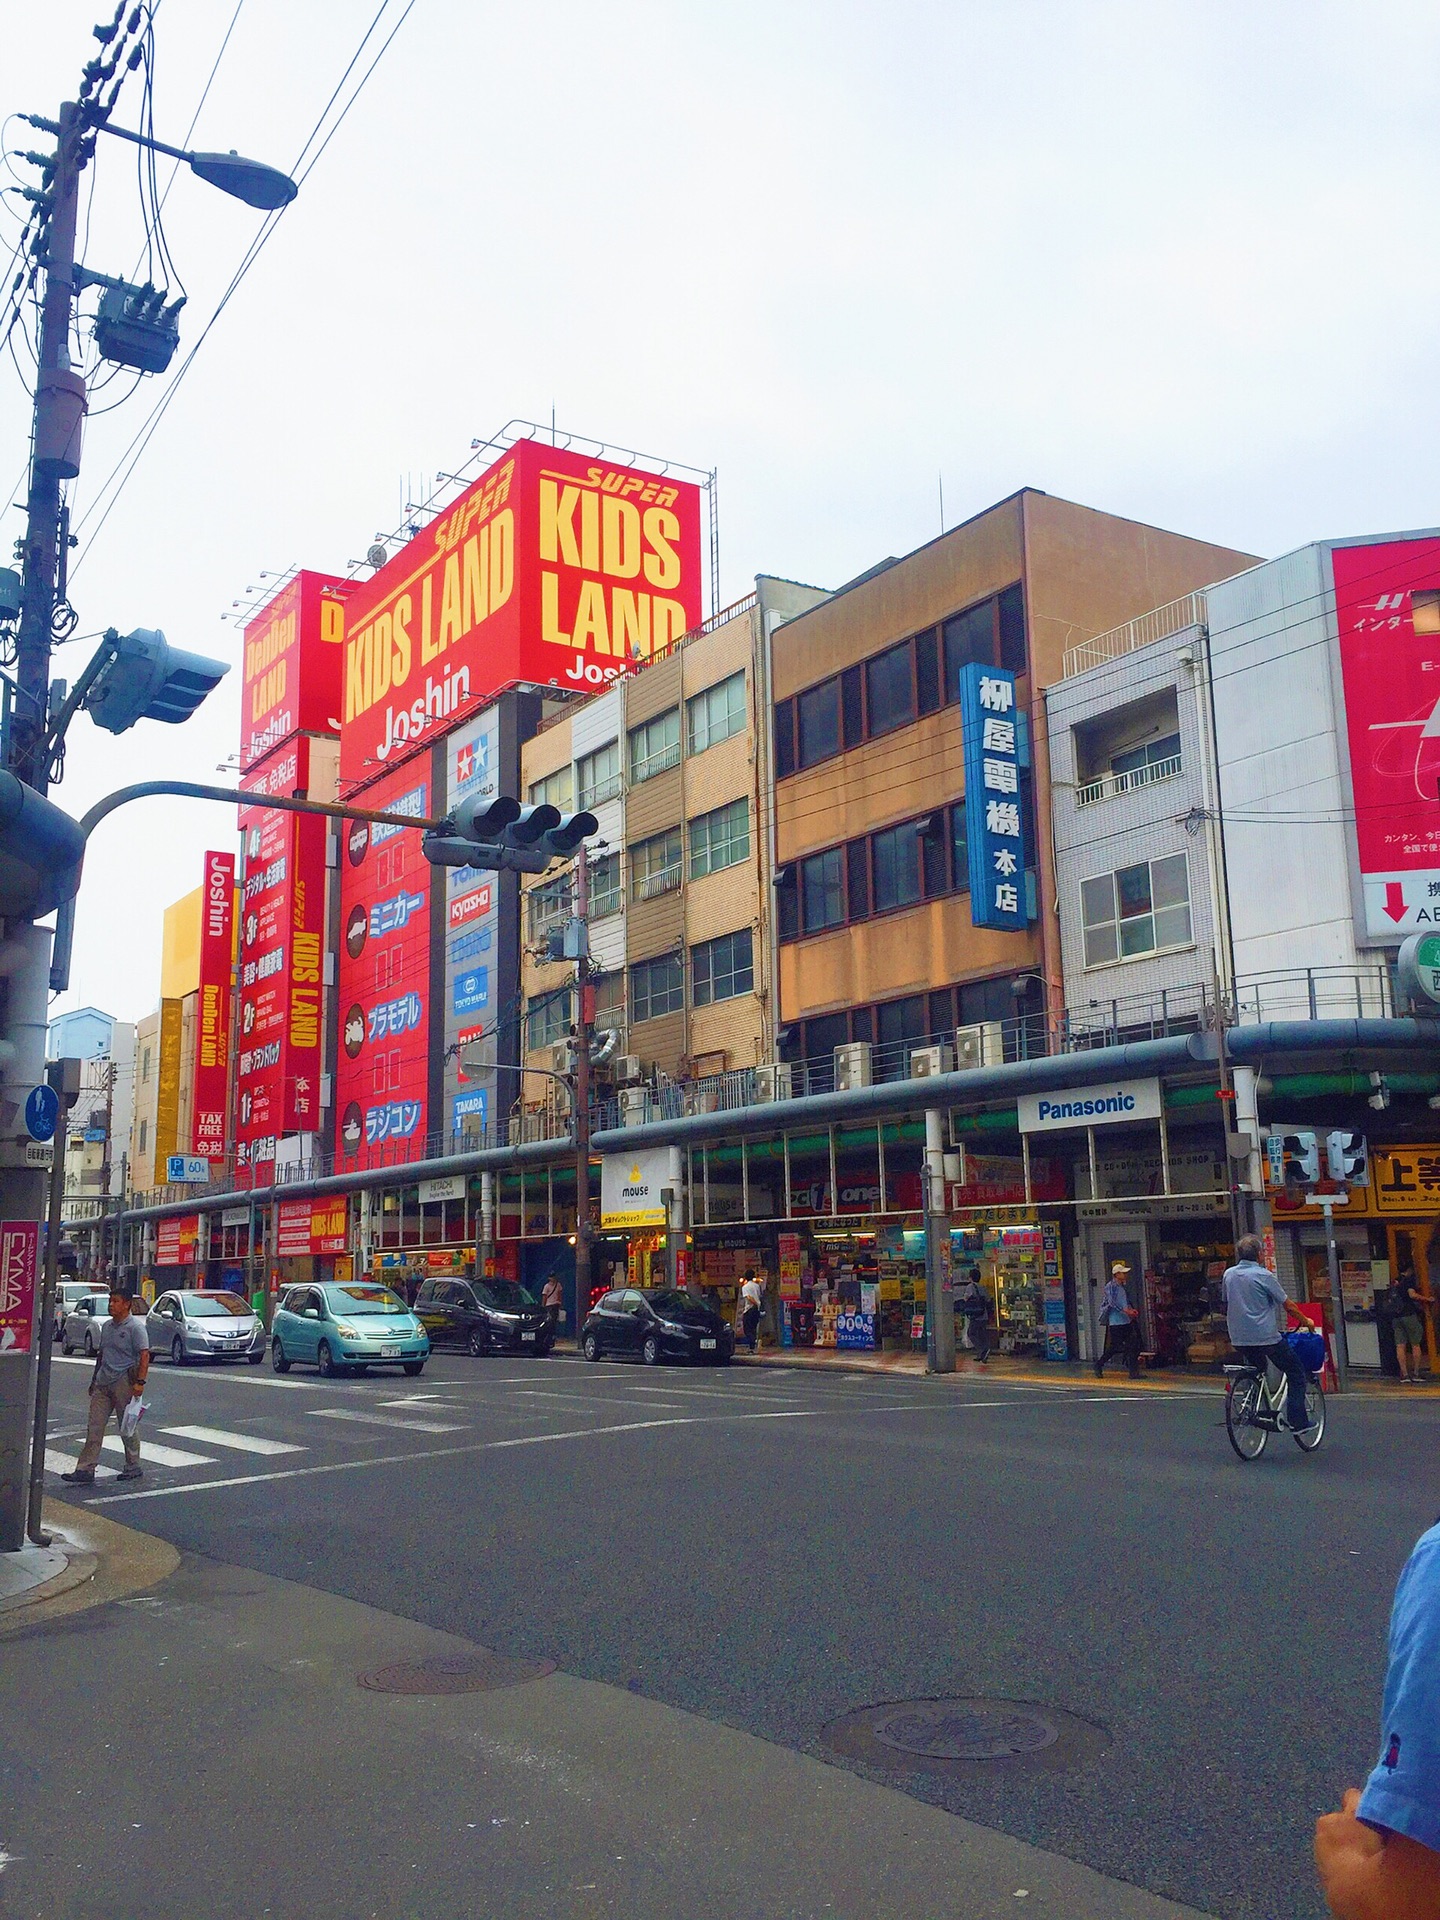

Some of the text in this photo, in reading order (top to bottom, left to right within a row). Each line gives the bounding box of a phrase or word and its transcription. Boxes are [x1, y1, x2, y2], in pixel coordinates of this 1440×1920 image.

[434, 458, 516, 554] SUPER
[588, 467, 680, 508] SUPER
[539, 478, 681, 590] KIDS
[345, 507, 514, 724] KIDS LAND
[541, 570, 687, 661] LAND
[245, 609, 296, 685] DenDen
[252, 658, 287, 725] LAND
[376, 662, 470, 761] Joshin
[246, 709, 291, 763] Joshin
[209, 856, 231, 938] Joshin
[294, 880, 305, 930] SUPER
[369, 894, 420, 936] ミニカー
[452, 889, 489, 920] KYOSHO
[290, 931, 320, 1049] KIDS LAND
[200, 984, 219, 1068] DenDen LAND
[368, 995, 419, 1039] プラモデル
[296, 1077, 309, 1114] 本店
[455, 1096, 483, 1112] TAKARA
[1038, 1090, 1135, 1121] Panasonic
[199, 1114, 222, 1124] TAX
[199, 1125, 222, 1136] FREE
[365, 1104, 418, 1142] ラジコン
[173, 1159, 182, 1170] P
[197, 1141, 222, 1157] 免税
[622, 1185, 649, 1198] mouse
[327, 1210, 347, 1236] LAND
[724, 1238, 747, 1248] mouse
[6, 1232, 26, 1312] CYMA
